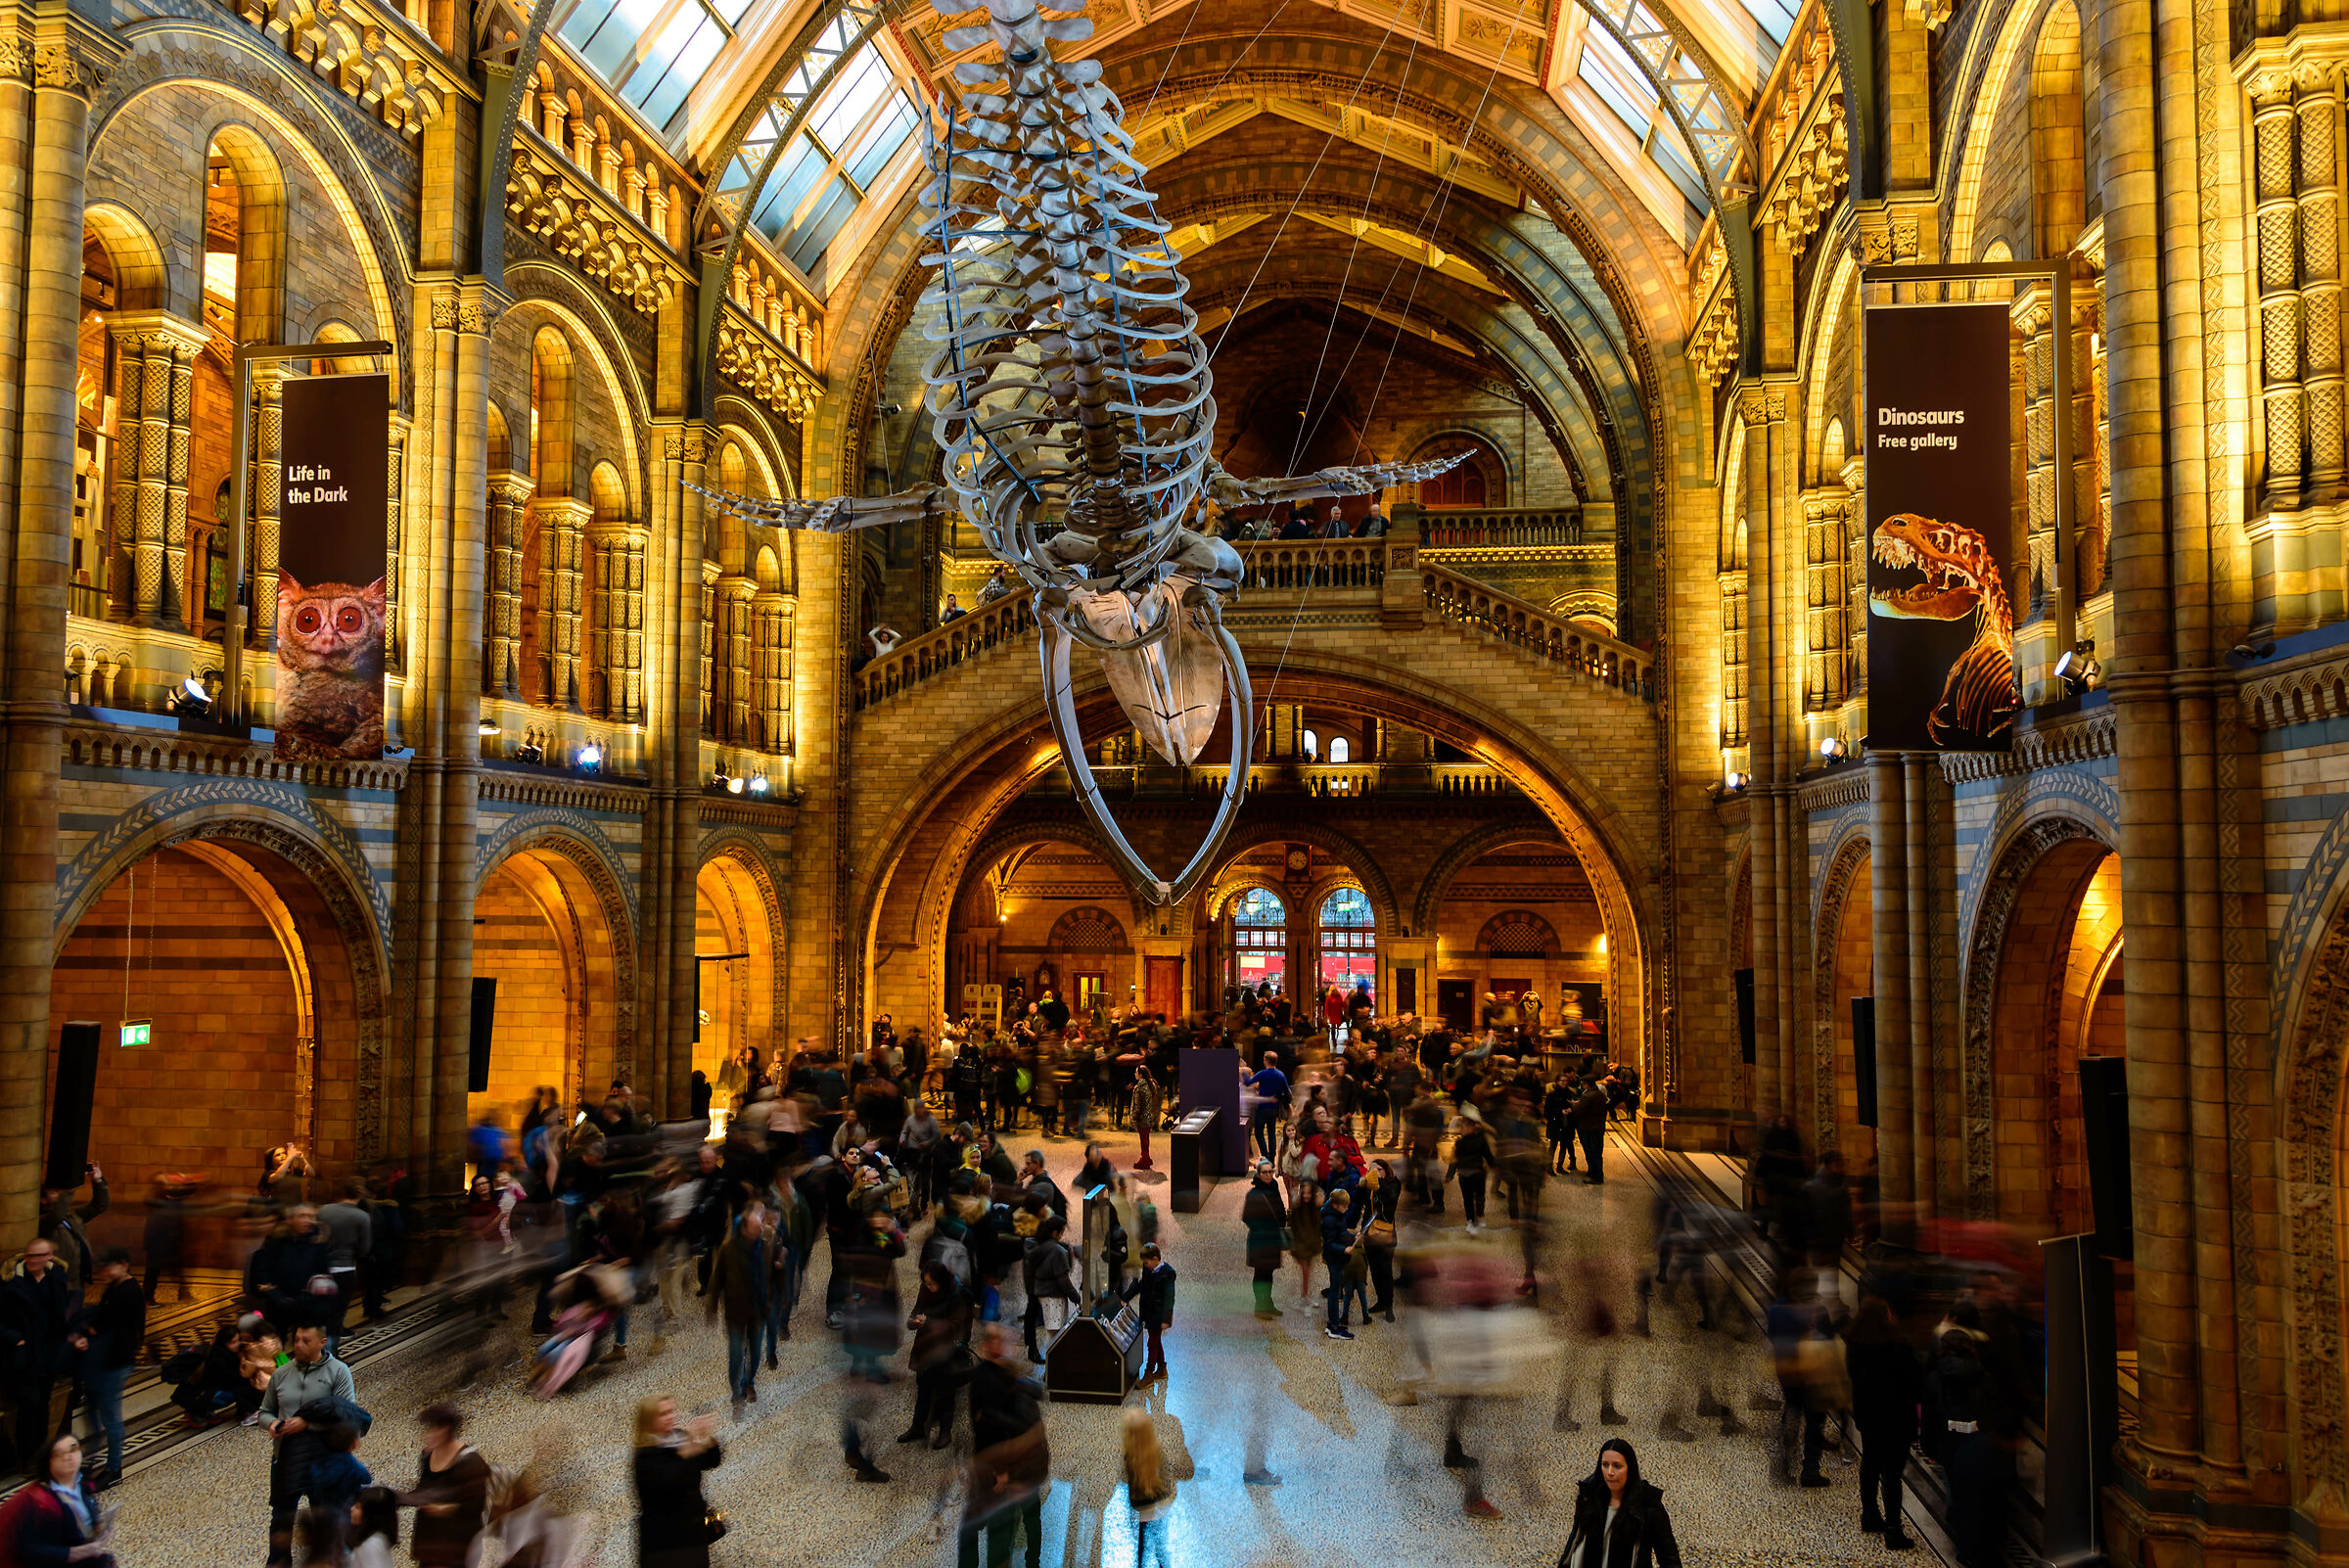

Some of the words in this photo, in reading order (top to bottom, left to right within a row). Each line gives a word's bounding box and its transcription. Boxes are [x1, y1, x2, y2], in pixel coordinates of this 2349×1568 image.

[1878, 407, 1965, 426] Dinosaurs
[1878, 434, 1908, 448] Free
[1911, 433, 1958, 451] gallery
[289, 465, 314, 482] Life
[318, 464, 331, 481] in
[288, 487, 311, 504] the
[314, 485, 348, 503] Dark
